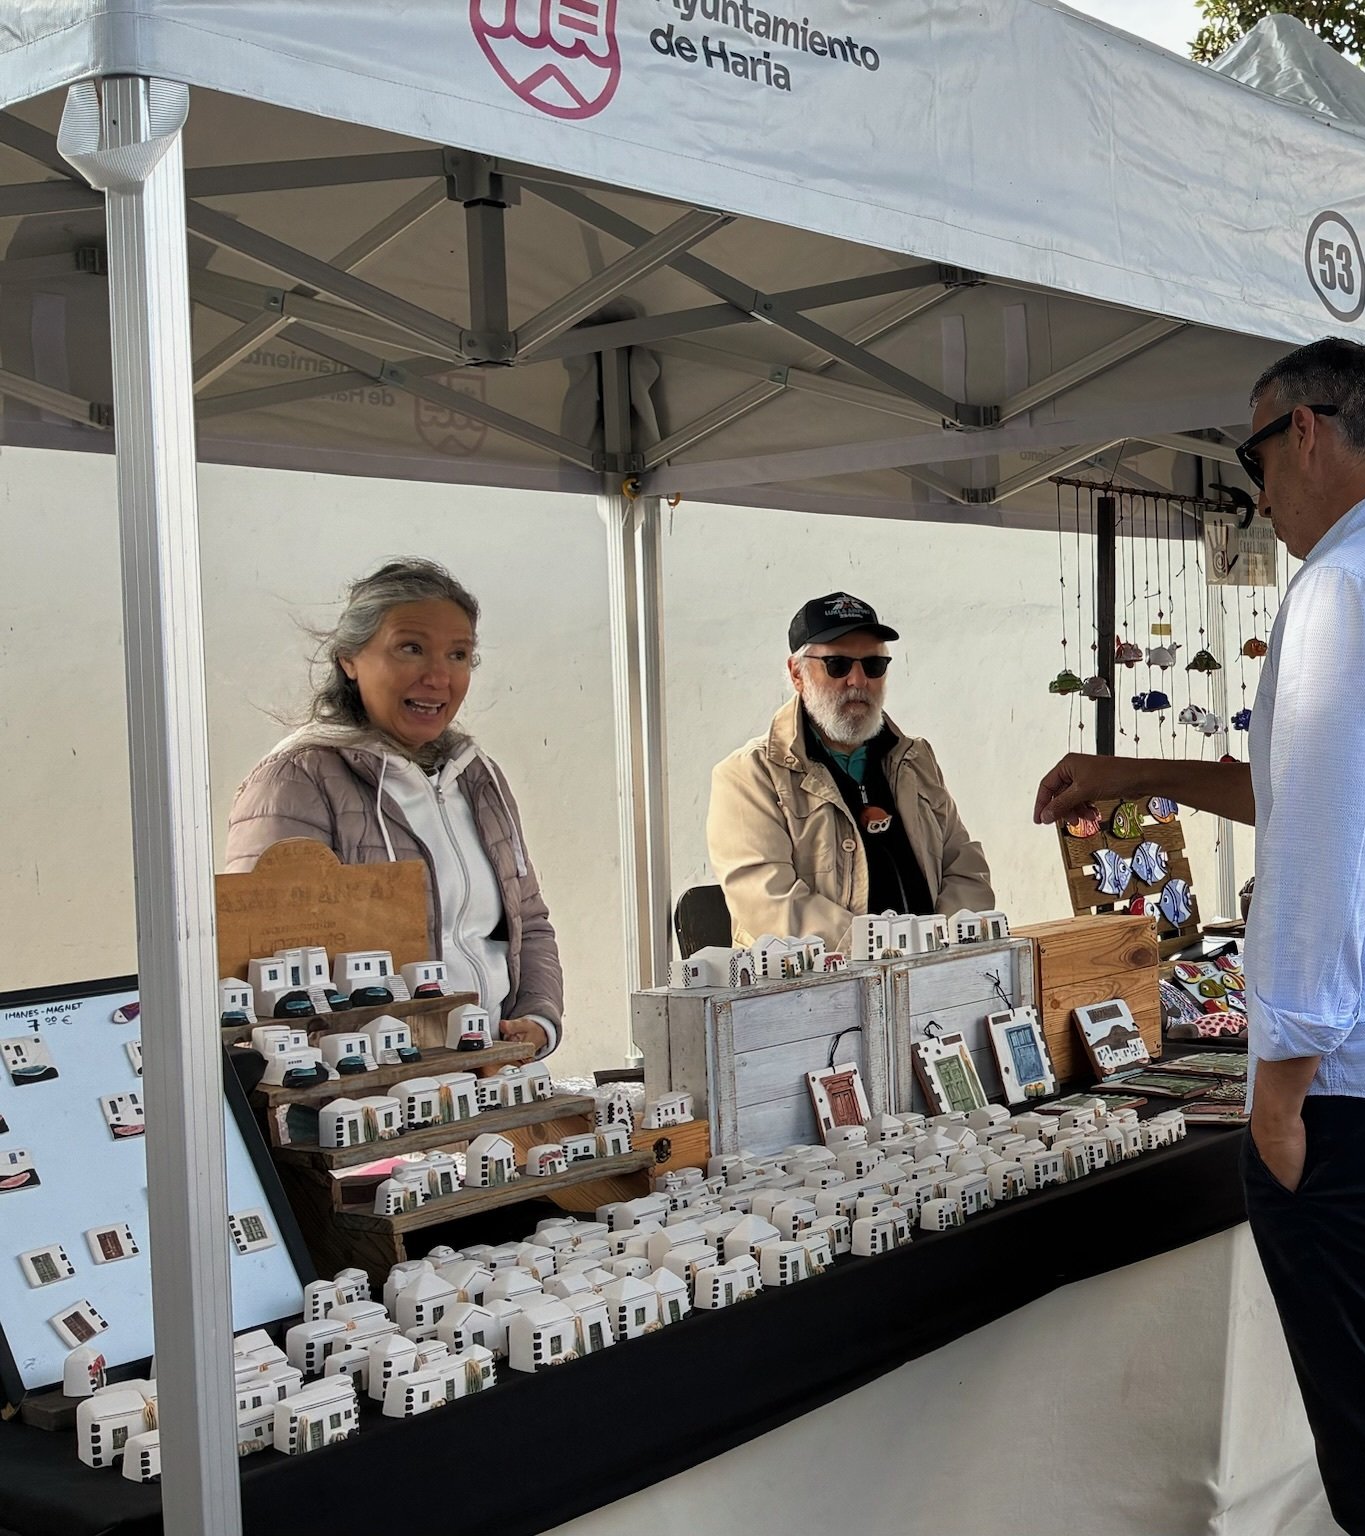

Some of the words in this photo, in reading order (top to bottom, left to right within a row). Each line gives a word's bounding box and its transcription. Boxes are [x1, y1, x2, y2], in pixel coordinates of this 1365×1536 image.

[649, 23, 698, 63] de
[656, 0, 880, 71] yuntamiento
[1318, 238, 1355, 295] 53
